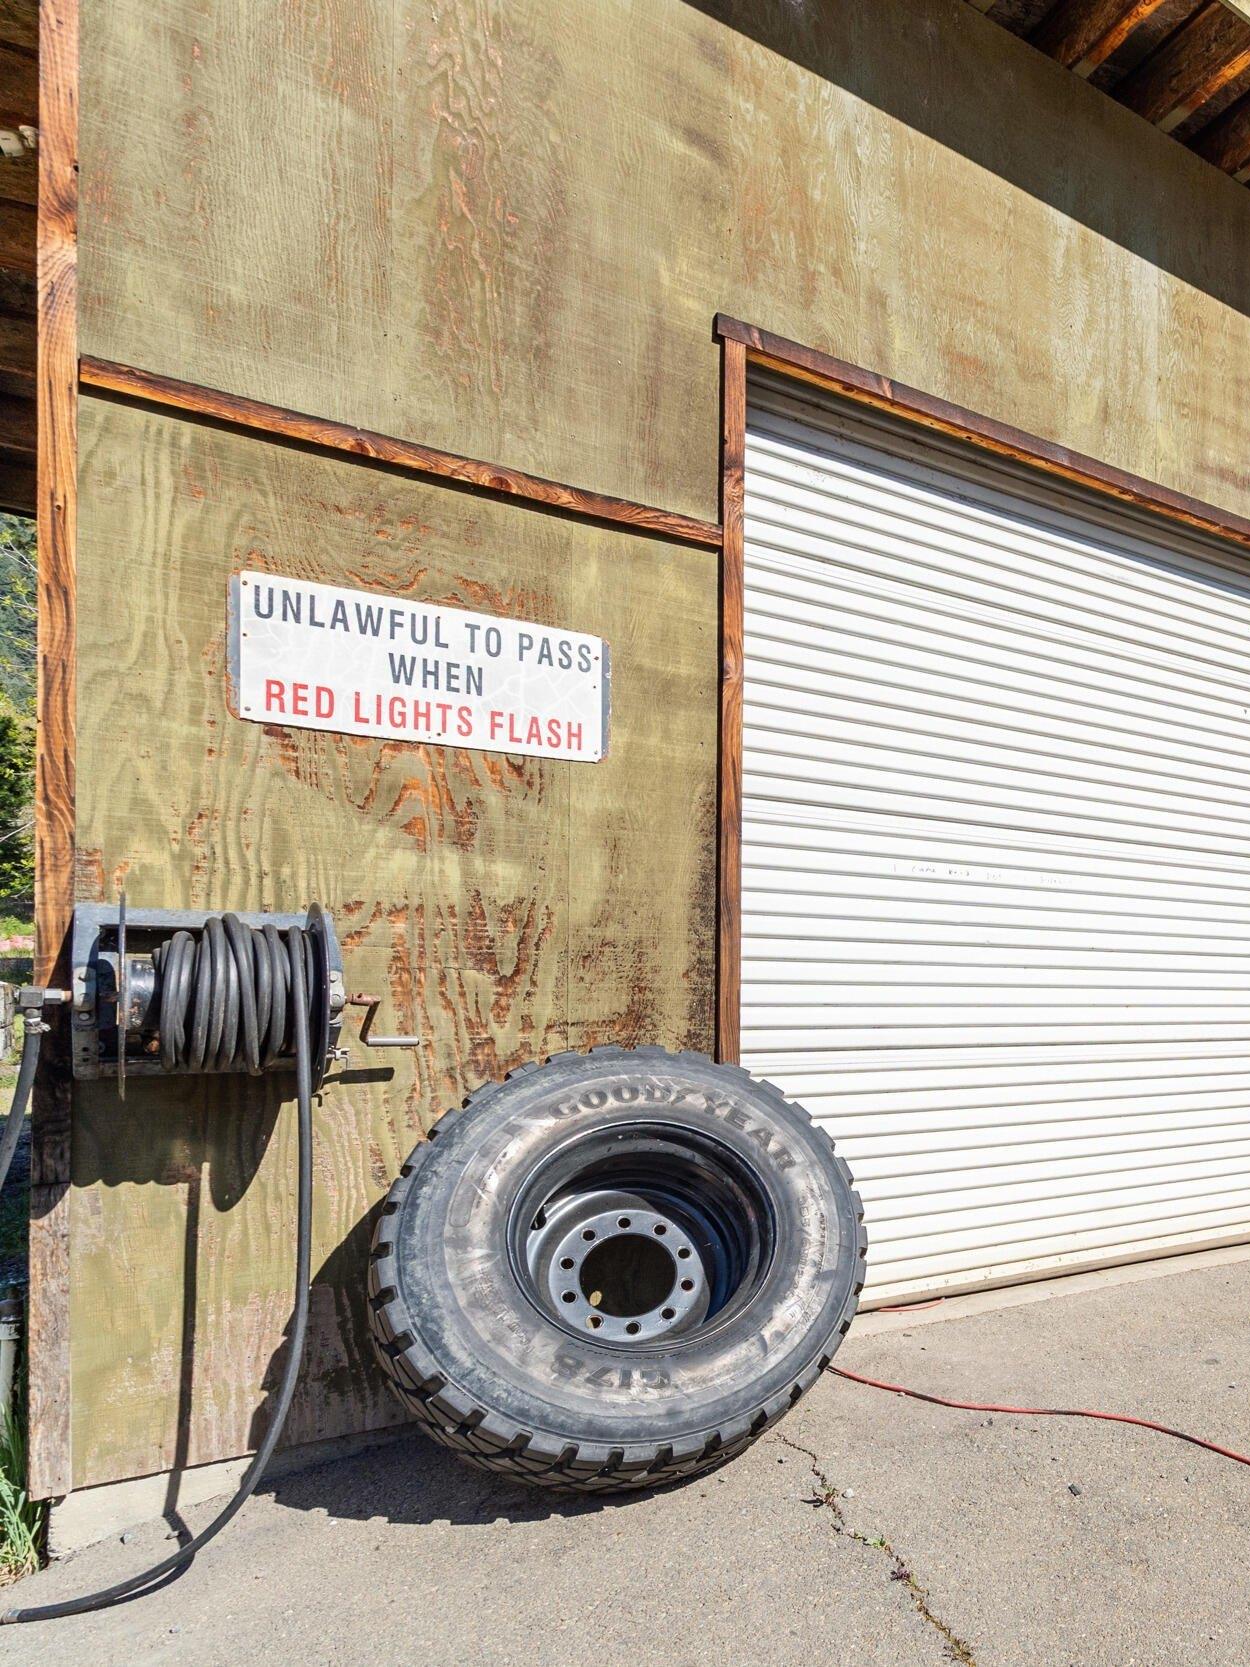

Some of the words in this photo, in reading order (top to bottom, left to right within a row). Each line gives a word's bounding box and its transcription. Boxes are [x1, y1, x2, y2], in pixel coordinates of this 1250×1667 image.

[254, 584, 449, 649] UNLAWFUL
[464, 622, 502, 657] TO
[518, 632, 592, 673] PASS
[388, 652, 484, 696] WHEN
[265, 679, 335, 718] RED
[353, 691, 473, 737] LIGHTS
[490, 710, 583, 751] FLASH
[549, 1085, 797, 1172] GOODYEAR
